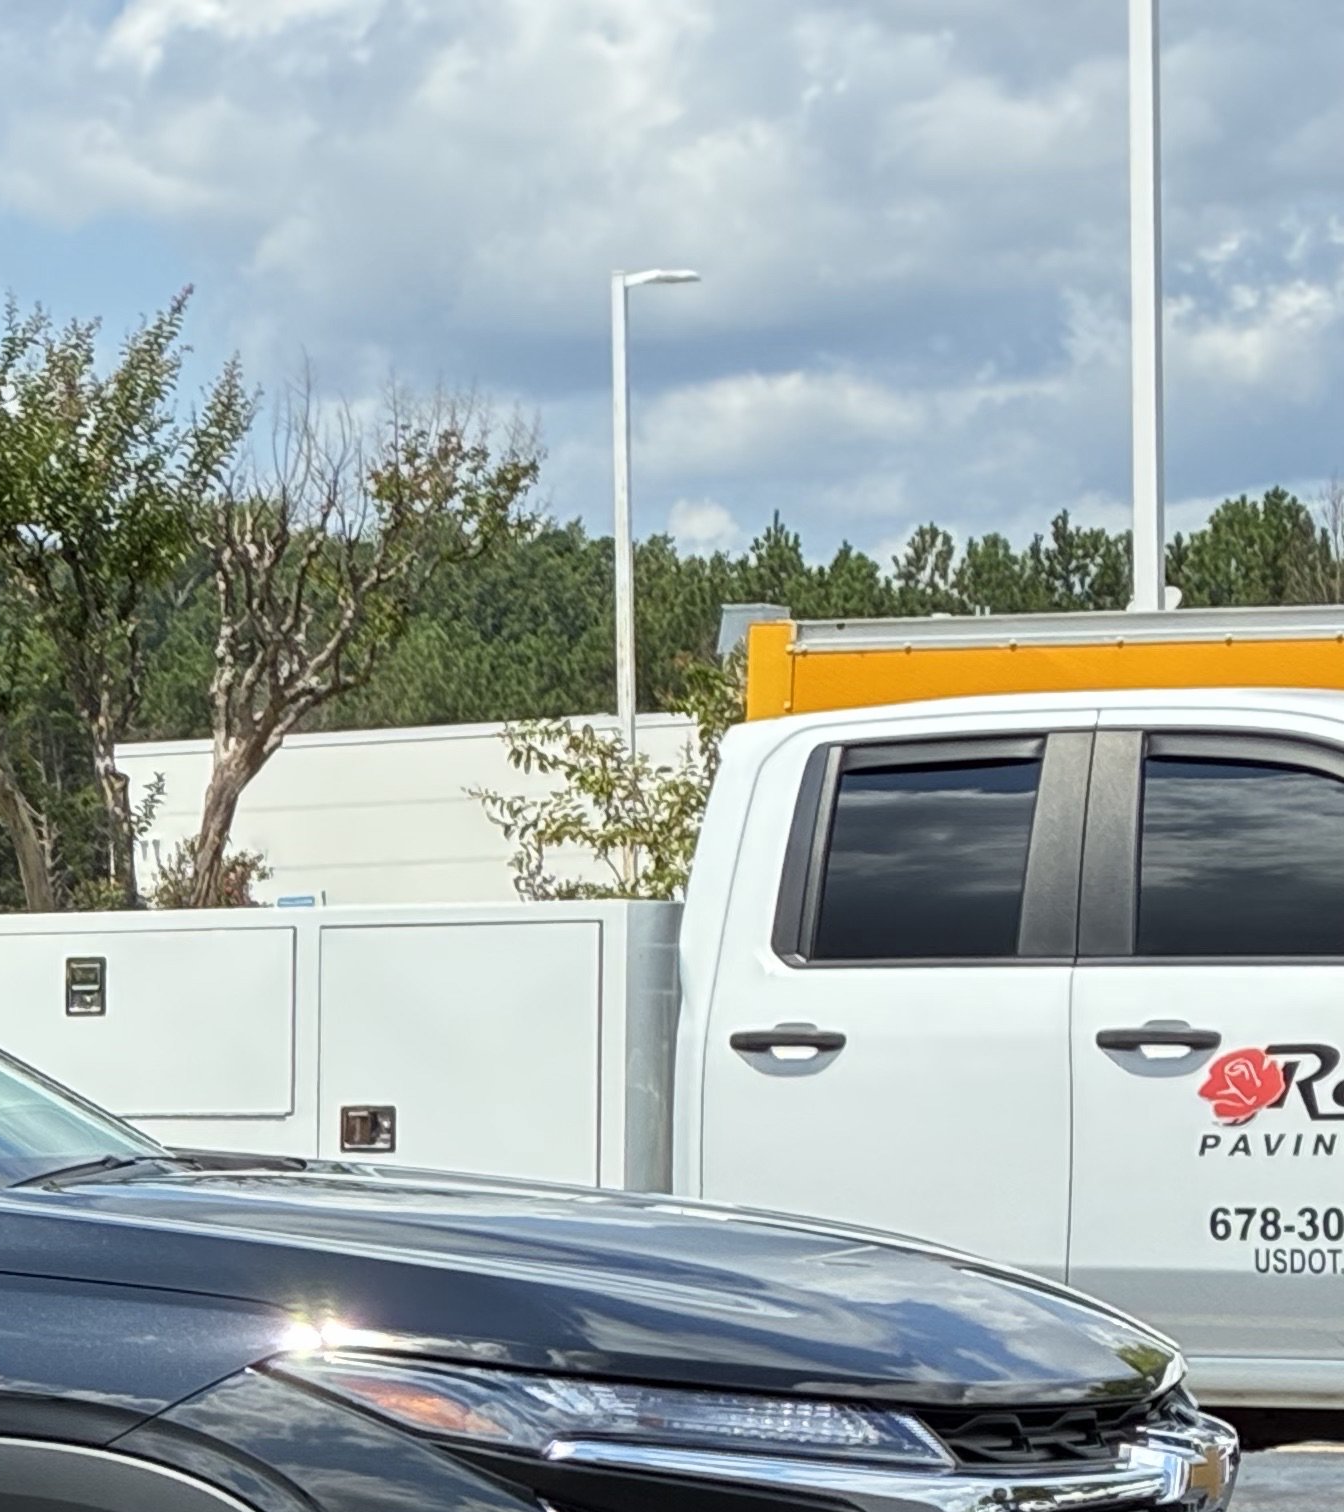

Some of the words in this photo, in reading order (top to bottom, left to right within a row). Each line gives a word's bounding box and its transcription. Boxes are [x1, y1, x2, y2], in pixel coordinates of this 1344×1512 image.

[1265, 1043, 1344, 1121] R
[1198, 1133, 1337, 1157] PAVIN
[1210, 1206, 1344, 1242] 678-30
